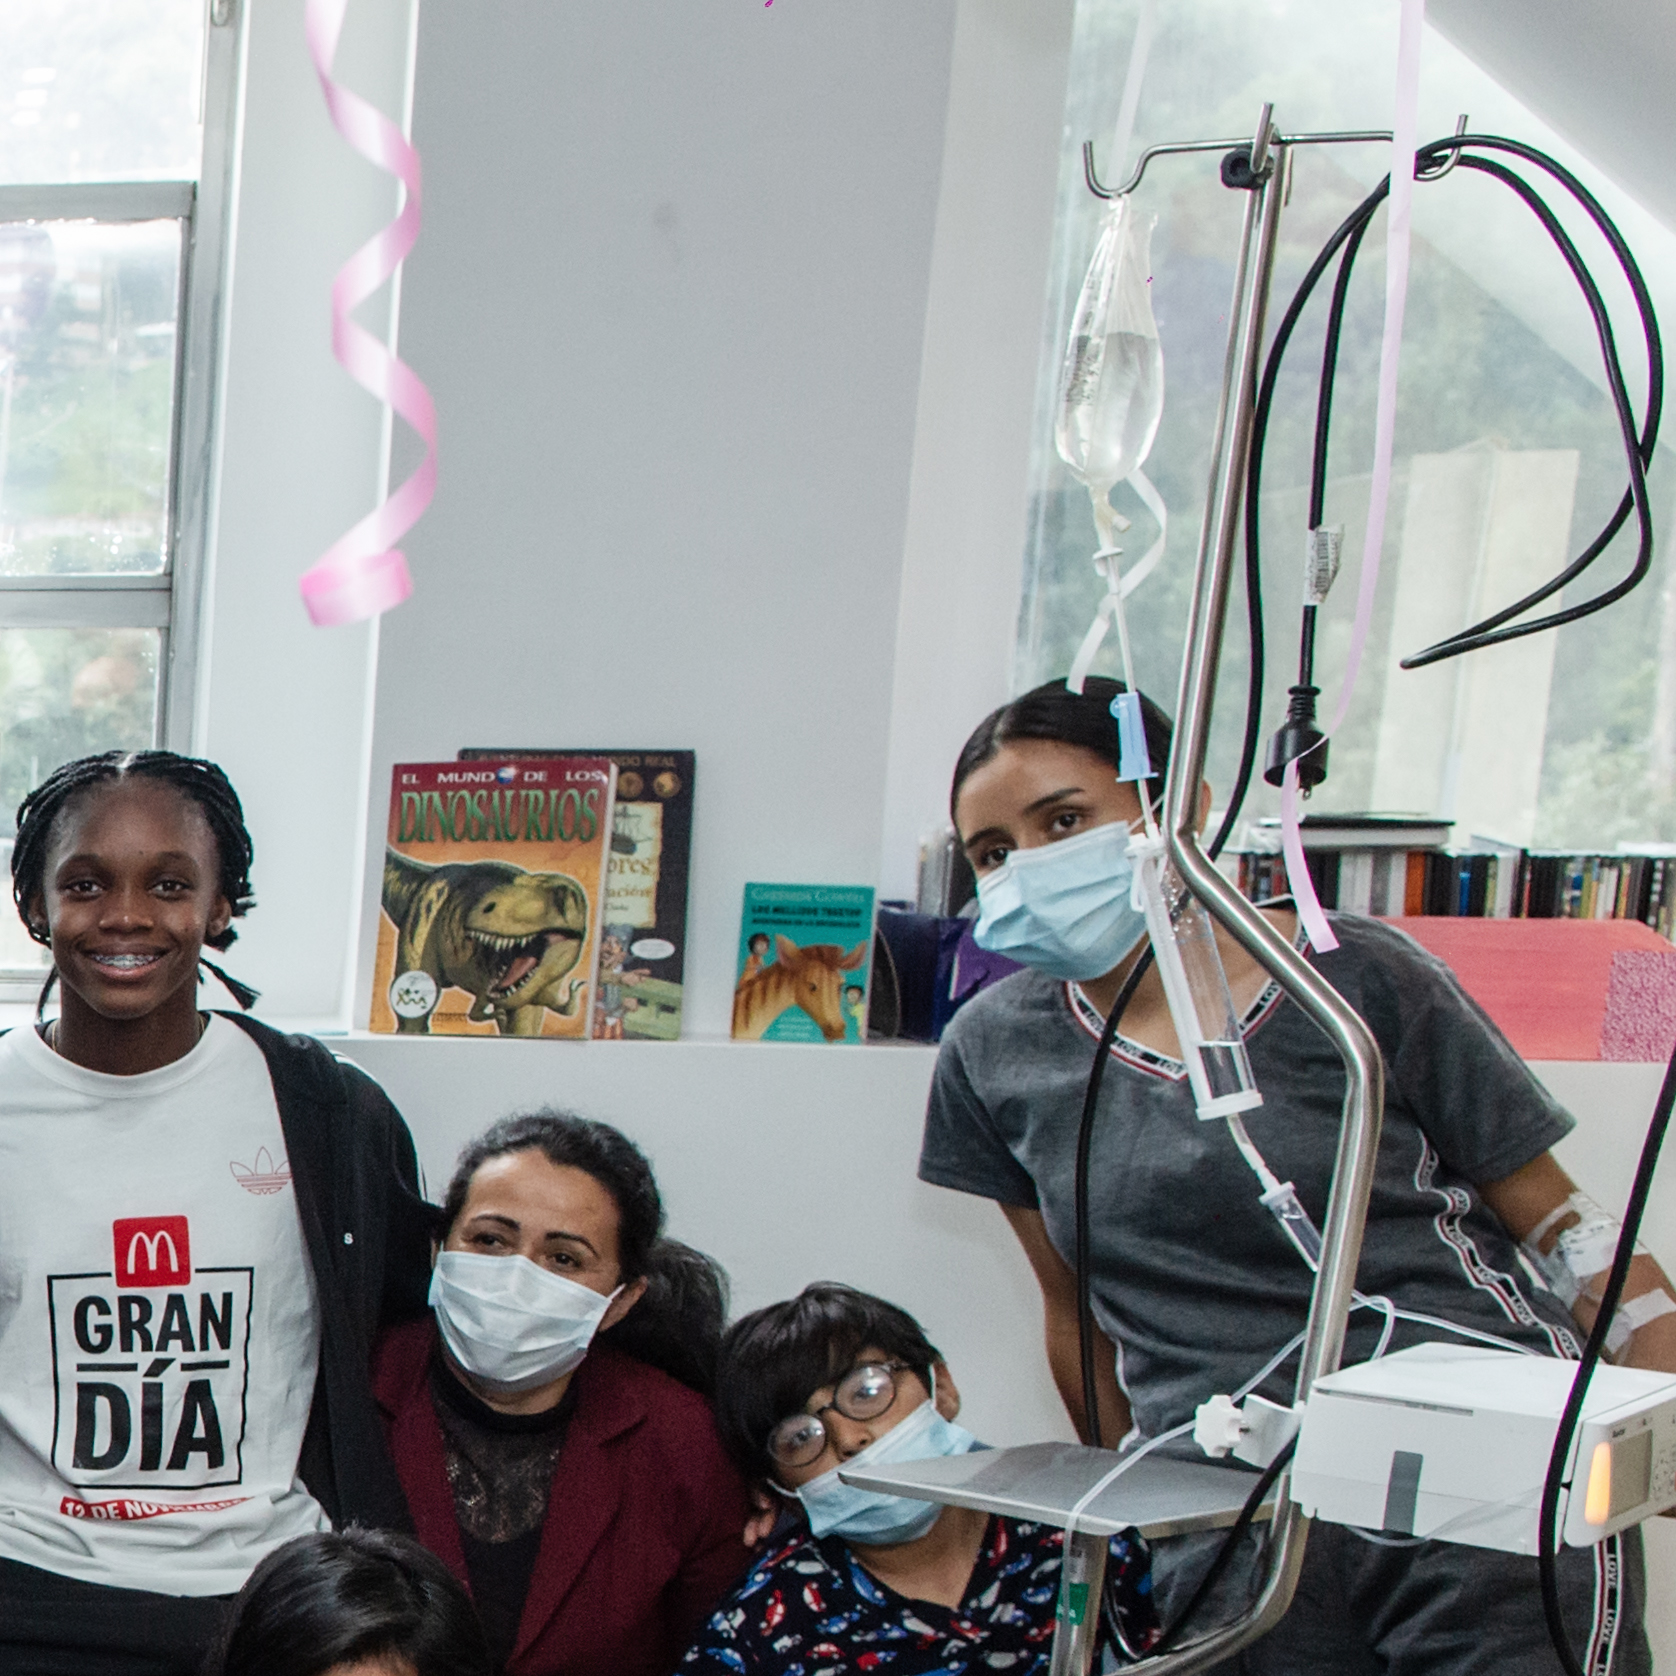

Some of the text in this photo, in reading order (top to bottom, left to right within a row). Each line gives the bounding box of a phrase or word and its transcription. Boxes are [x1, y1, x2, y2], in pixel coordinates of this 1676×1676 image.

[402, 774, 420, 785] EL
[524, 771, 547, 782] DE
[566, 770, 603, 783] LOS
[398, 788, 599, 843] DINOSAURIOS
[1157, 1057, 1185, 1074] LOV
[73, 1291, 233, 1355] GRAN
[72, 1357, 225, 1471] DÍA
[64, 1501, 85, 1519] 12
[91, 1501, 121, 1520] DE
[1607, 1553, 1617, 1589] LOVE
[1603, 1609, 1616, 1644] LOVE
